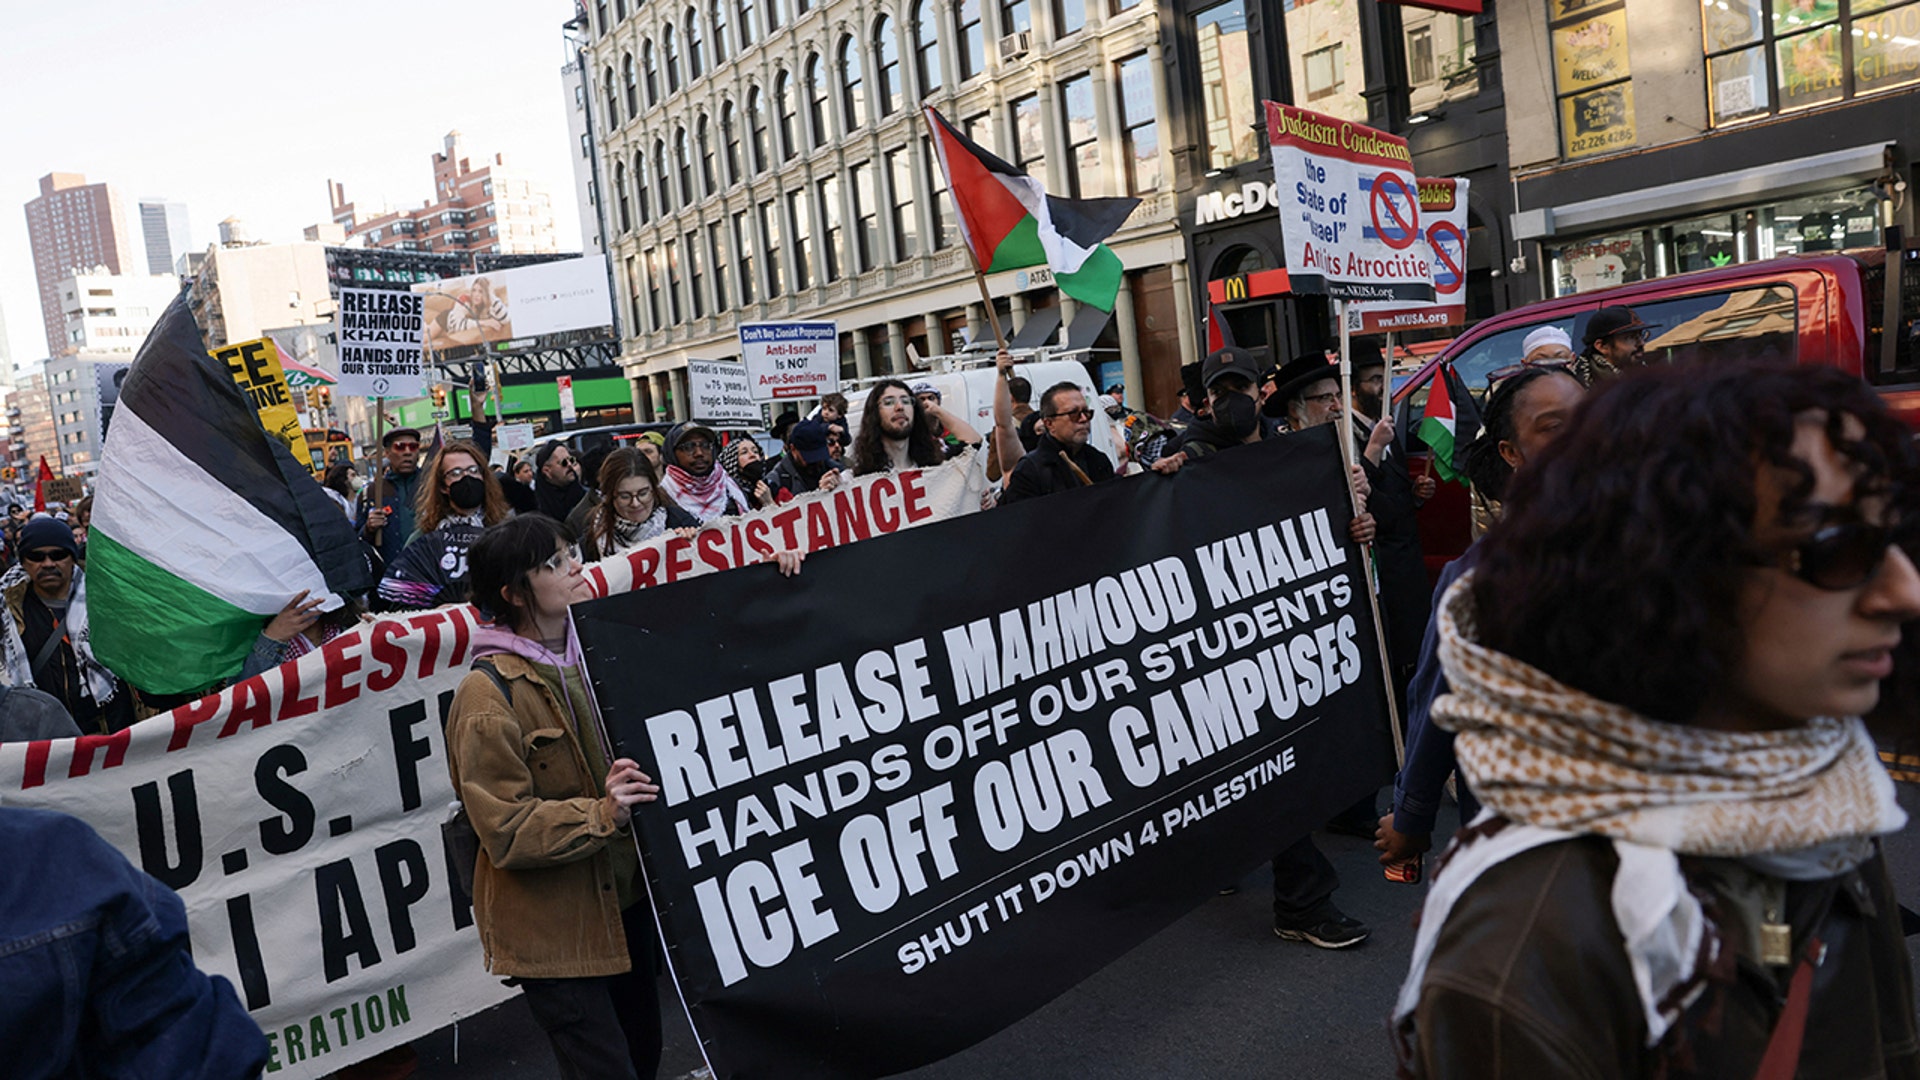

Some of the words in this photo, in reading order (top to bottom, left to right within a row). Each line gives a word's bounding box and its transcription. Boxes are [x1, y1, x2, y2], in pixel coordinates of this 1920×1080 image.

[1277, 106, 1338, 146] Judaism
[1304, 157, 1326, 183] the
[1328, 192, 1347, 215] of
[1416, 184, 1451, 204] abbis
[343, 292, 422, 316] RELEASE
[342, 313, 421, 331] MAHMOUD
[343, 329, 421, 343] KHALIL
[342, 347, 392, 363] HANDS
[396, 349, 420, 363] OFF
[766, 343, 816, 355] Anti-Israel
[341, 362, 364, 375] OUR
[367, 364, 420, 375] STUDENTS
[775, 359, 785, 370] Is
[787, 358, 808, 369] NOT
[759, 372, 827, 386] Anti-Semitism
[627, 470, 934, 592] RESISTANCE
[645, 638, 940, 807] RELEASE
[943, 557, 1197, 706] MAHMOUD
[1195, 508, 1347, 610] KHALIL
[674, 744, 912, 870] HANDS
[923, 698, 1021, 771] OFF
[1029, 659, 1137, 727] OUR
[1140, 574, 1352, 682] STUDENTS
[693, 838, 840, 988] ICE
[840, 781, 960, 914] OFF
[974, 729, 1113, 852] OUR
[1108, 614, 1362, 788] CAMPUSES
[897, 902, 990, 974] SHUT
[994, 884, 1023, 922] IT
[1029, 831, 1135, 903] DOWN
[1140, 820, 1160, 845] 4
[1162, 746, 1296, 837] PALESTINE
